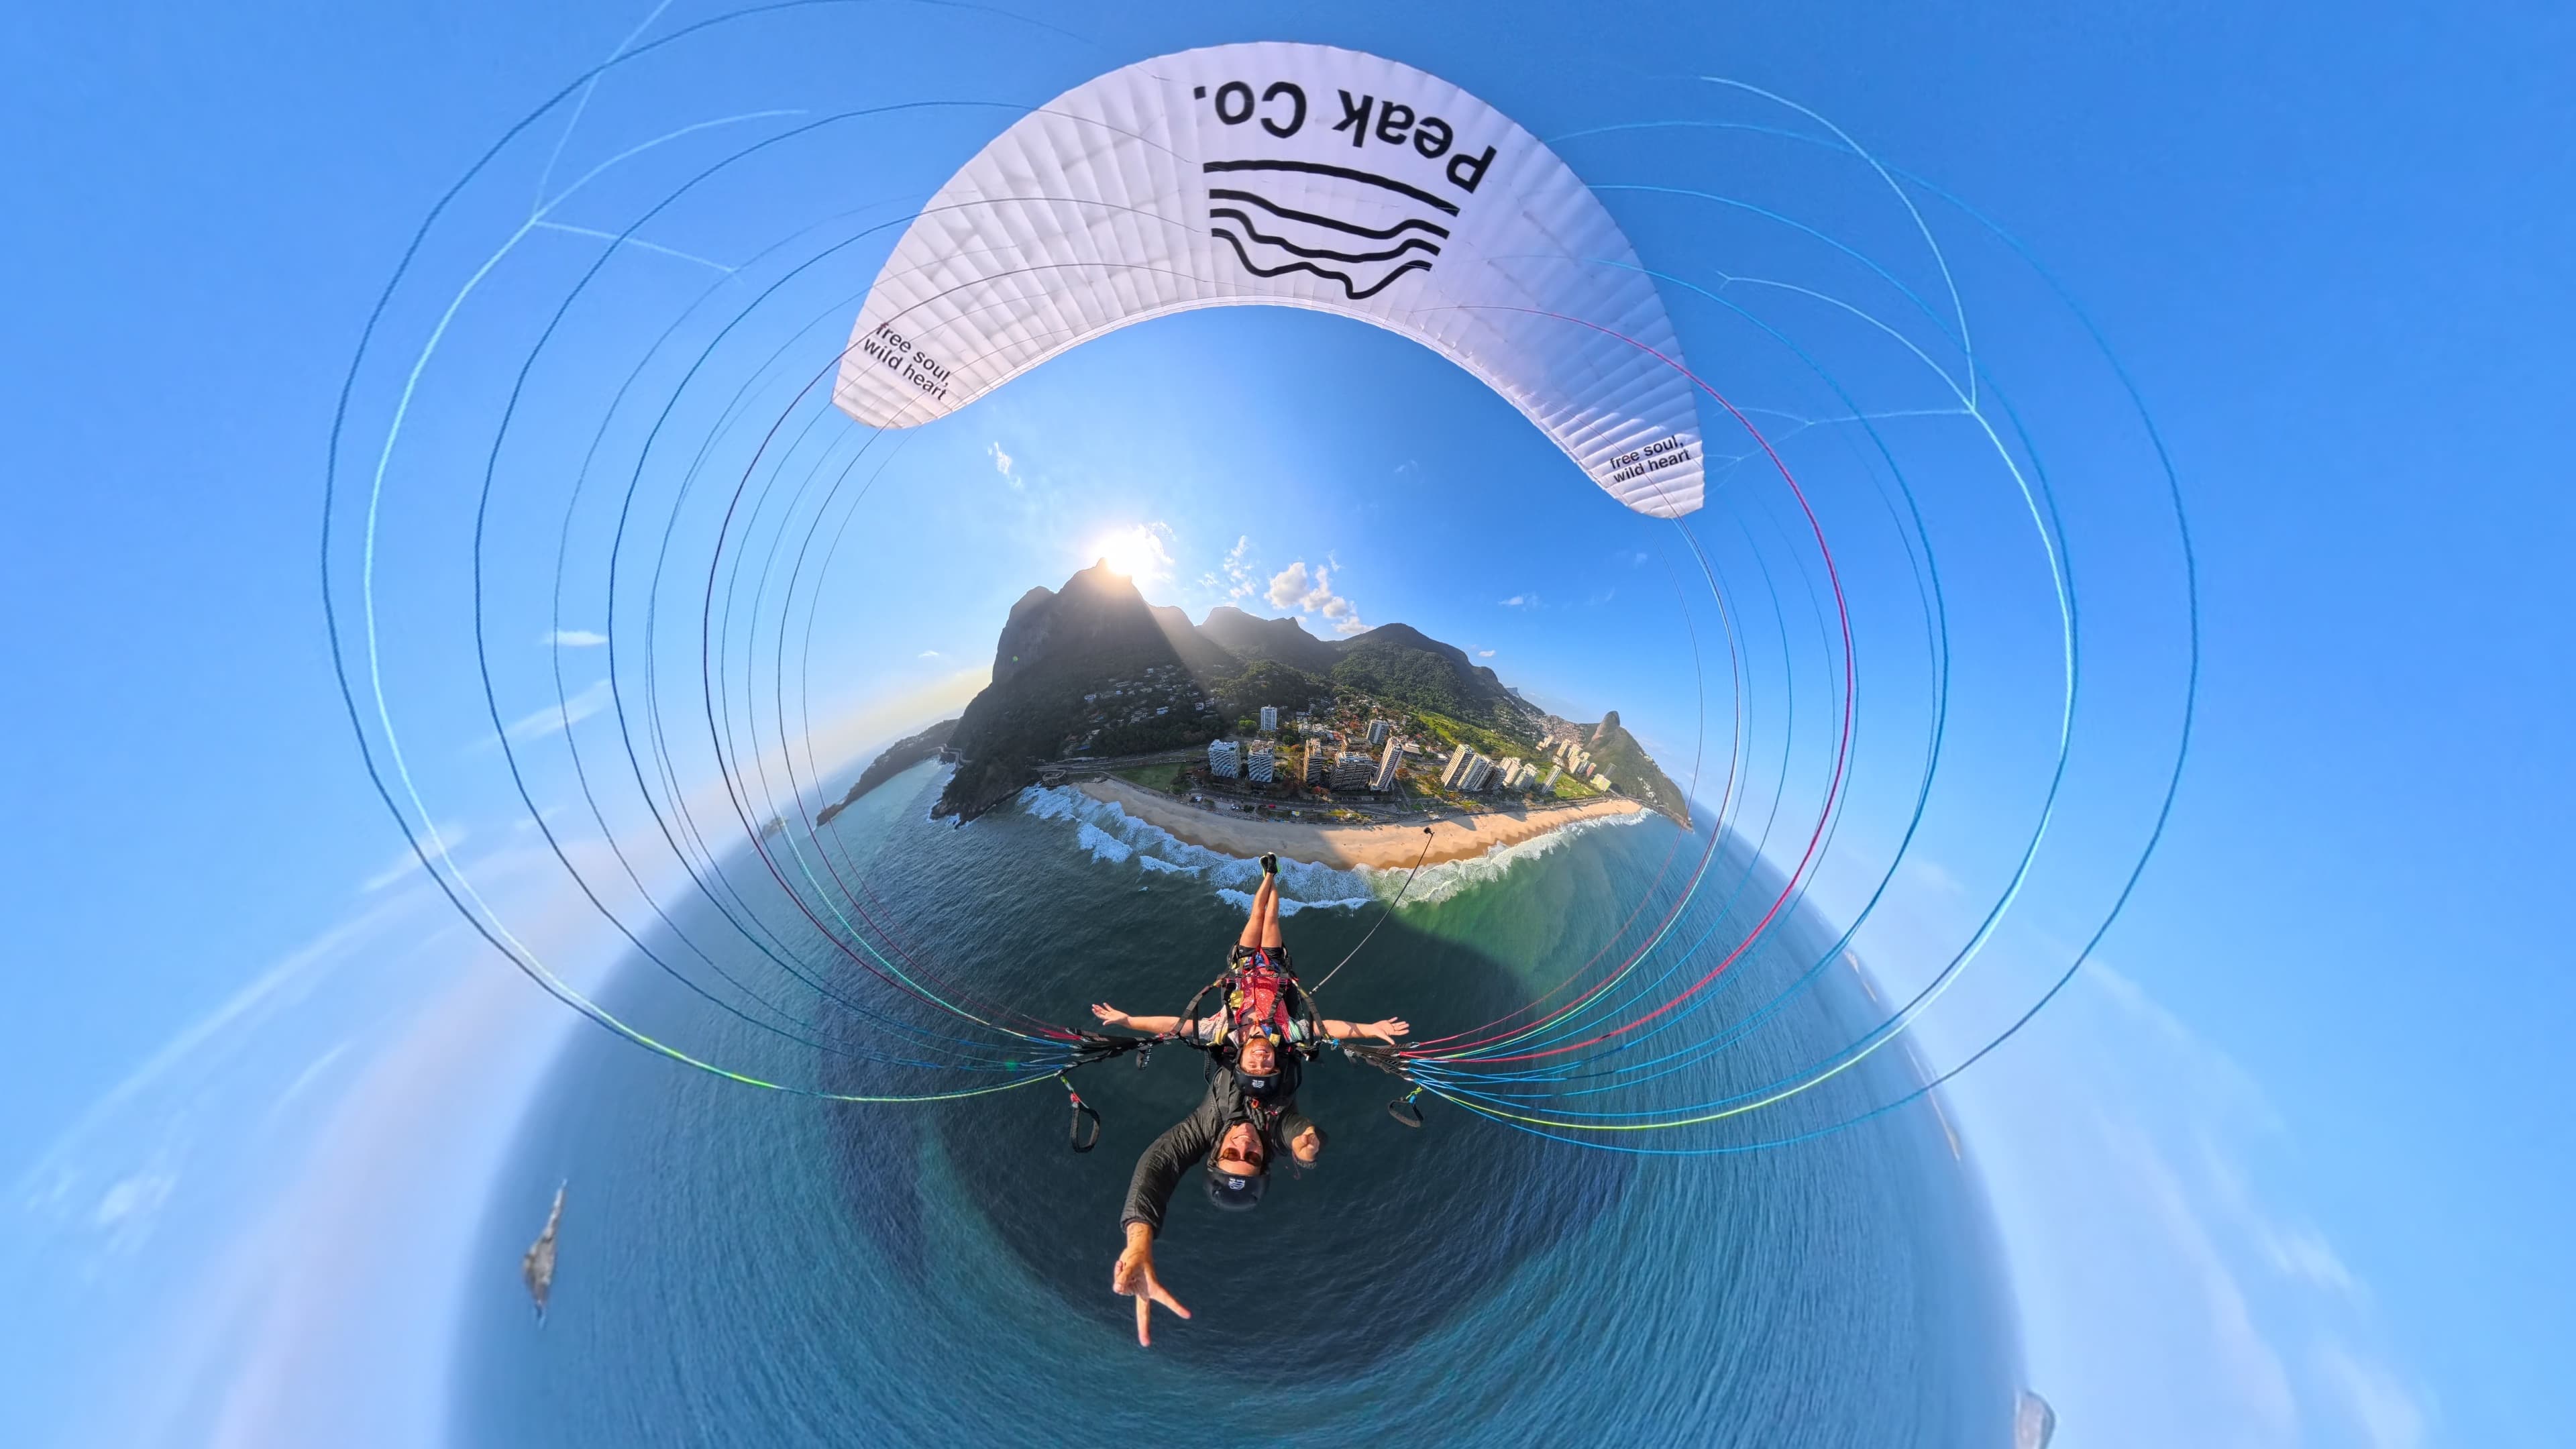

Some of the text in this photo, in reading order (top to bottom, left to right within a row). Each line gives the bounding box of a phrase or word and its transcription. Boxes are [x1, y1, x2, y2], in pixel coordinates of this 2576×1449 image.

[1193, 80, 1497, 194] Peak Co.
[864, 338, 947, 400] wild heart
[875, 323, 951, 387] free soul,
[1610, 435, 1684, 470] free soul,
[1613, 449, 1690, 483] wild heart
